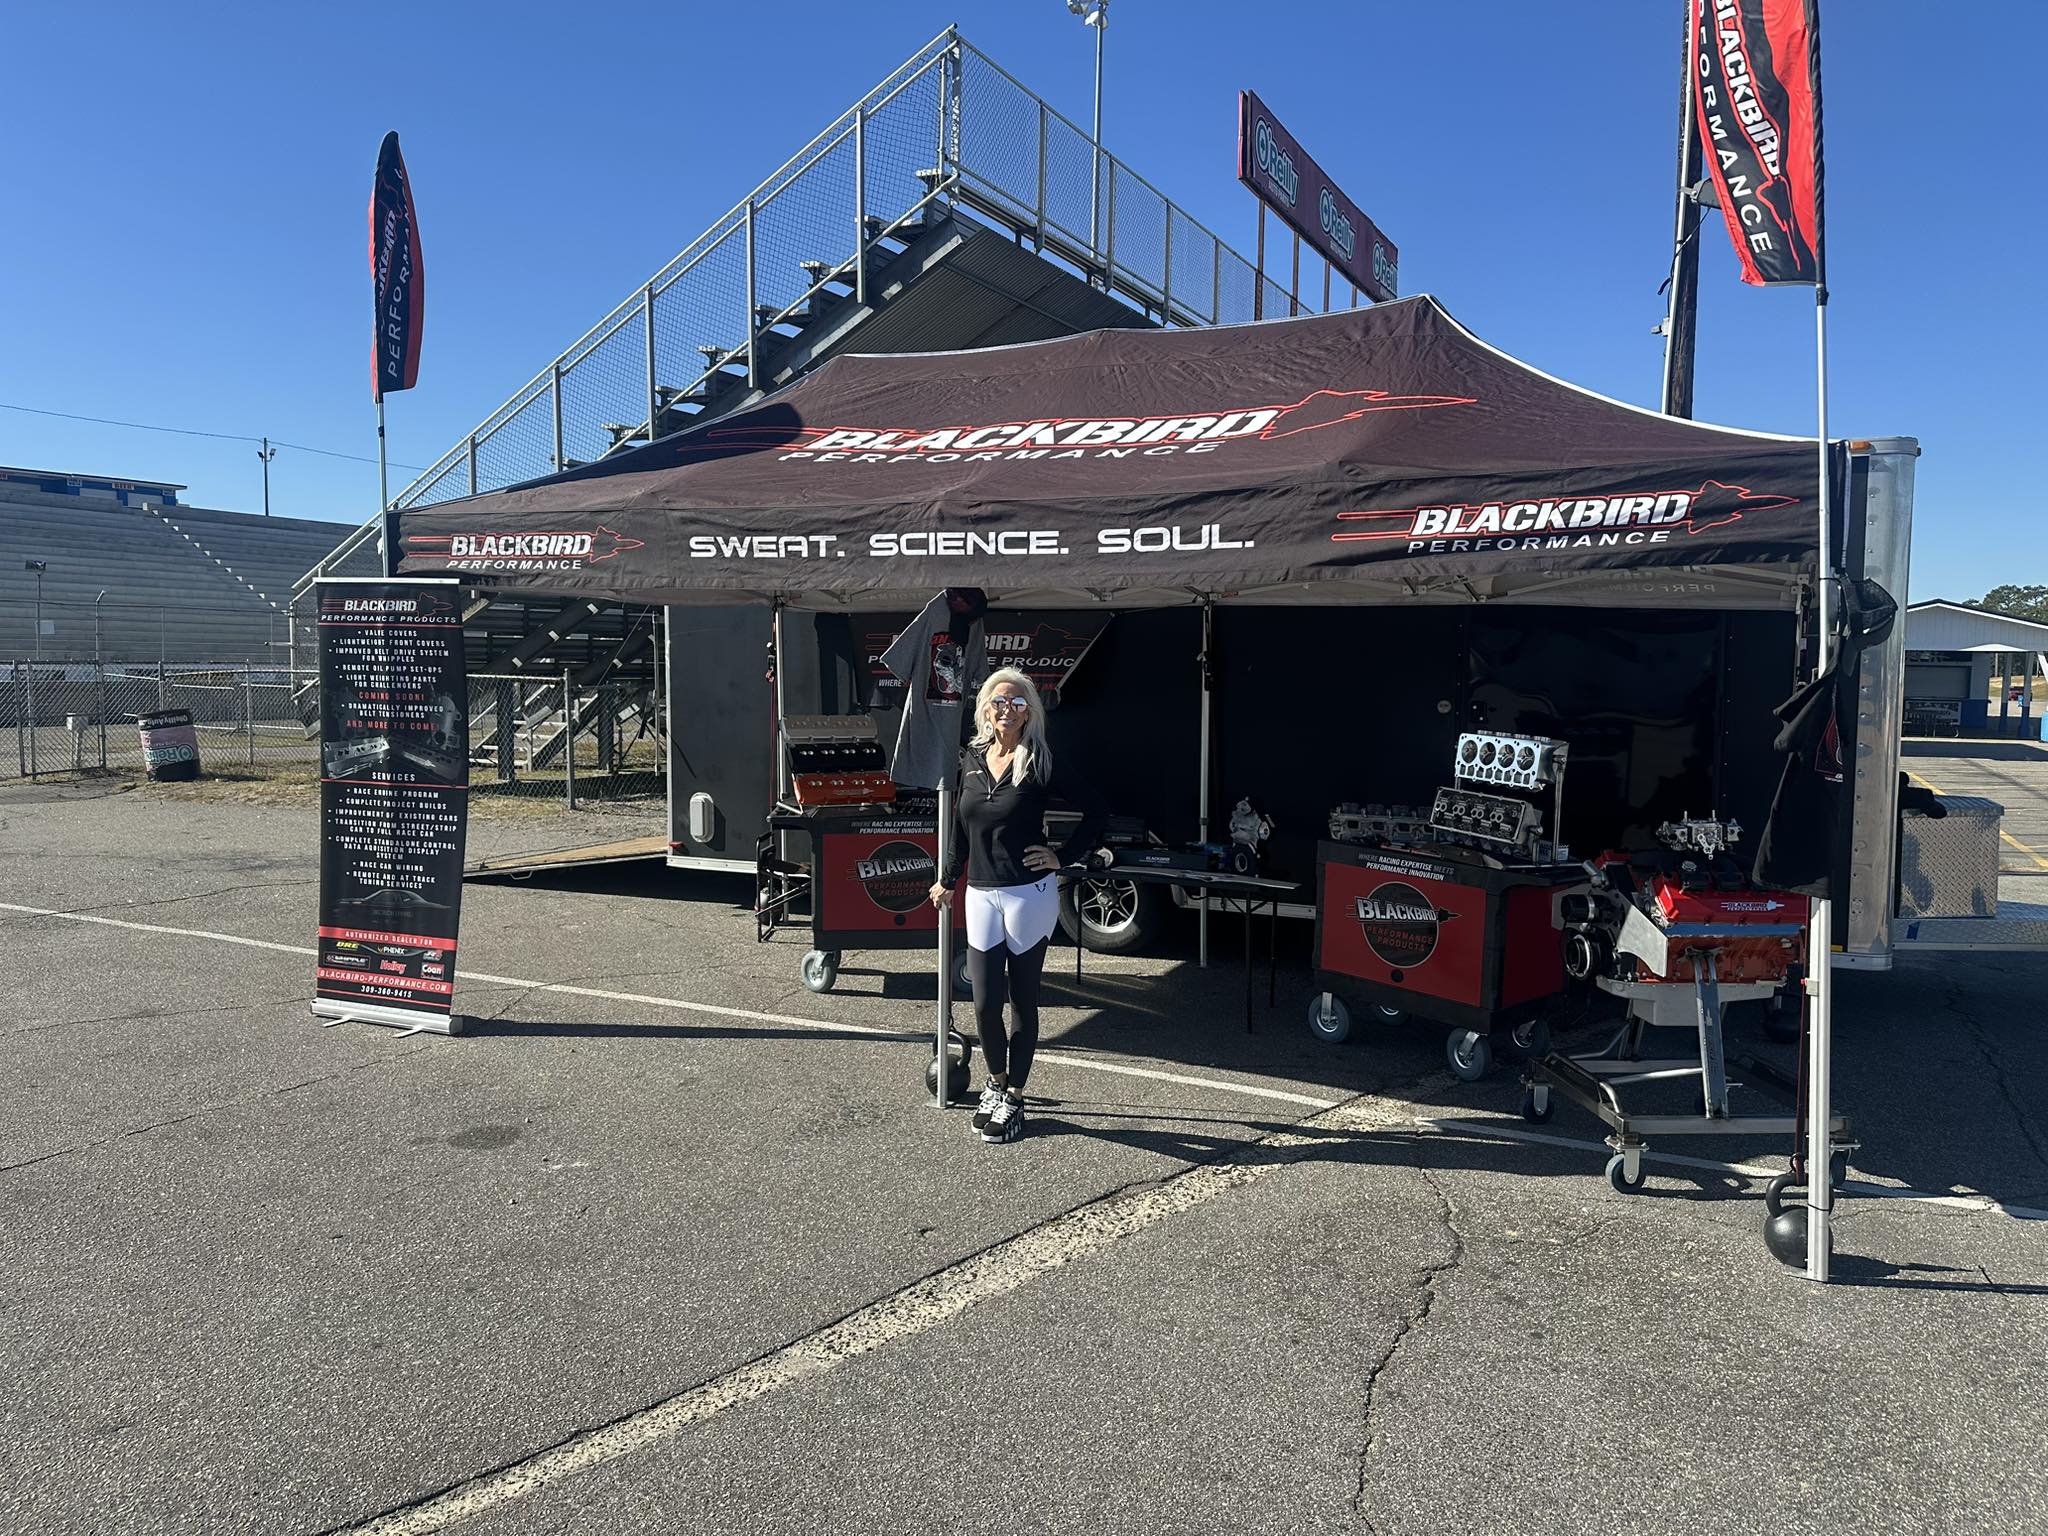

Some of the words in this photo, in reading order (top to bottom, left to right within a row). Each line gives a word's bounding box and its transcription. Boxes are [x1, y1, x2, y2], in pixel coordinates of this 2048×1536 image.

[1373, 242, 1397, 299] O'Reill
[804, 408, 1279, 449] BLACKBIRD
[779, 440, 1226, 464] PERFORMANCE
[1410, 493, 1691, 536] BLACKBIRD
[451, 534, 592, 556] BLACKBIRD
[689, 534, 845, 558] SWEAT.
[868, 531, 1069, 558] SCIENCE.
[1097, 525, 1254, 554] SOUL.
[1408, 530, 1671, 553] PERFORMANCE
[446, 559, 582, 570] PERFORMANCE
[345, 600, 416, 611] BLACKBIRD
[1001, 656, 1074, 668] PRODUC
[372, 772, 415, 781] SERVICES
[346, 798, 381, 806] COMPLETE
[383, 800, 415, 808] PROJECT
[336, 809, 383, 817] IMPROVEMENT
[336, 836, 371, 844] COMPLETE
[857, 858, 935, 879] BLACKBIRD
[1366, 862, 1408, 875] PERFORMANCE
[1408, 869, 1445, 881] INNOVATION
[1378, 855, 1400, 866] RACING
[1400, 859, 1433, 871] EXPERTISE
[387, 881, 422, 889] SERVICES
[1357, 899, 1437, 921] BLACKBIRD
[1368, 927, 1433, 945] PERFORMANCE
[422, 964, 442, 974] Coan
[320, 971, 447, 991] BLACKBIRD-PERFORMANCE.COM
